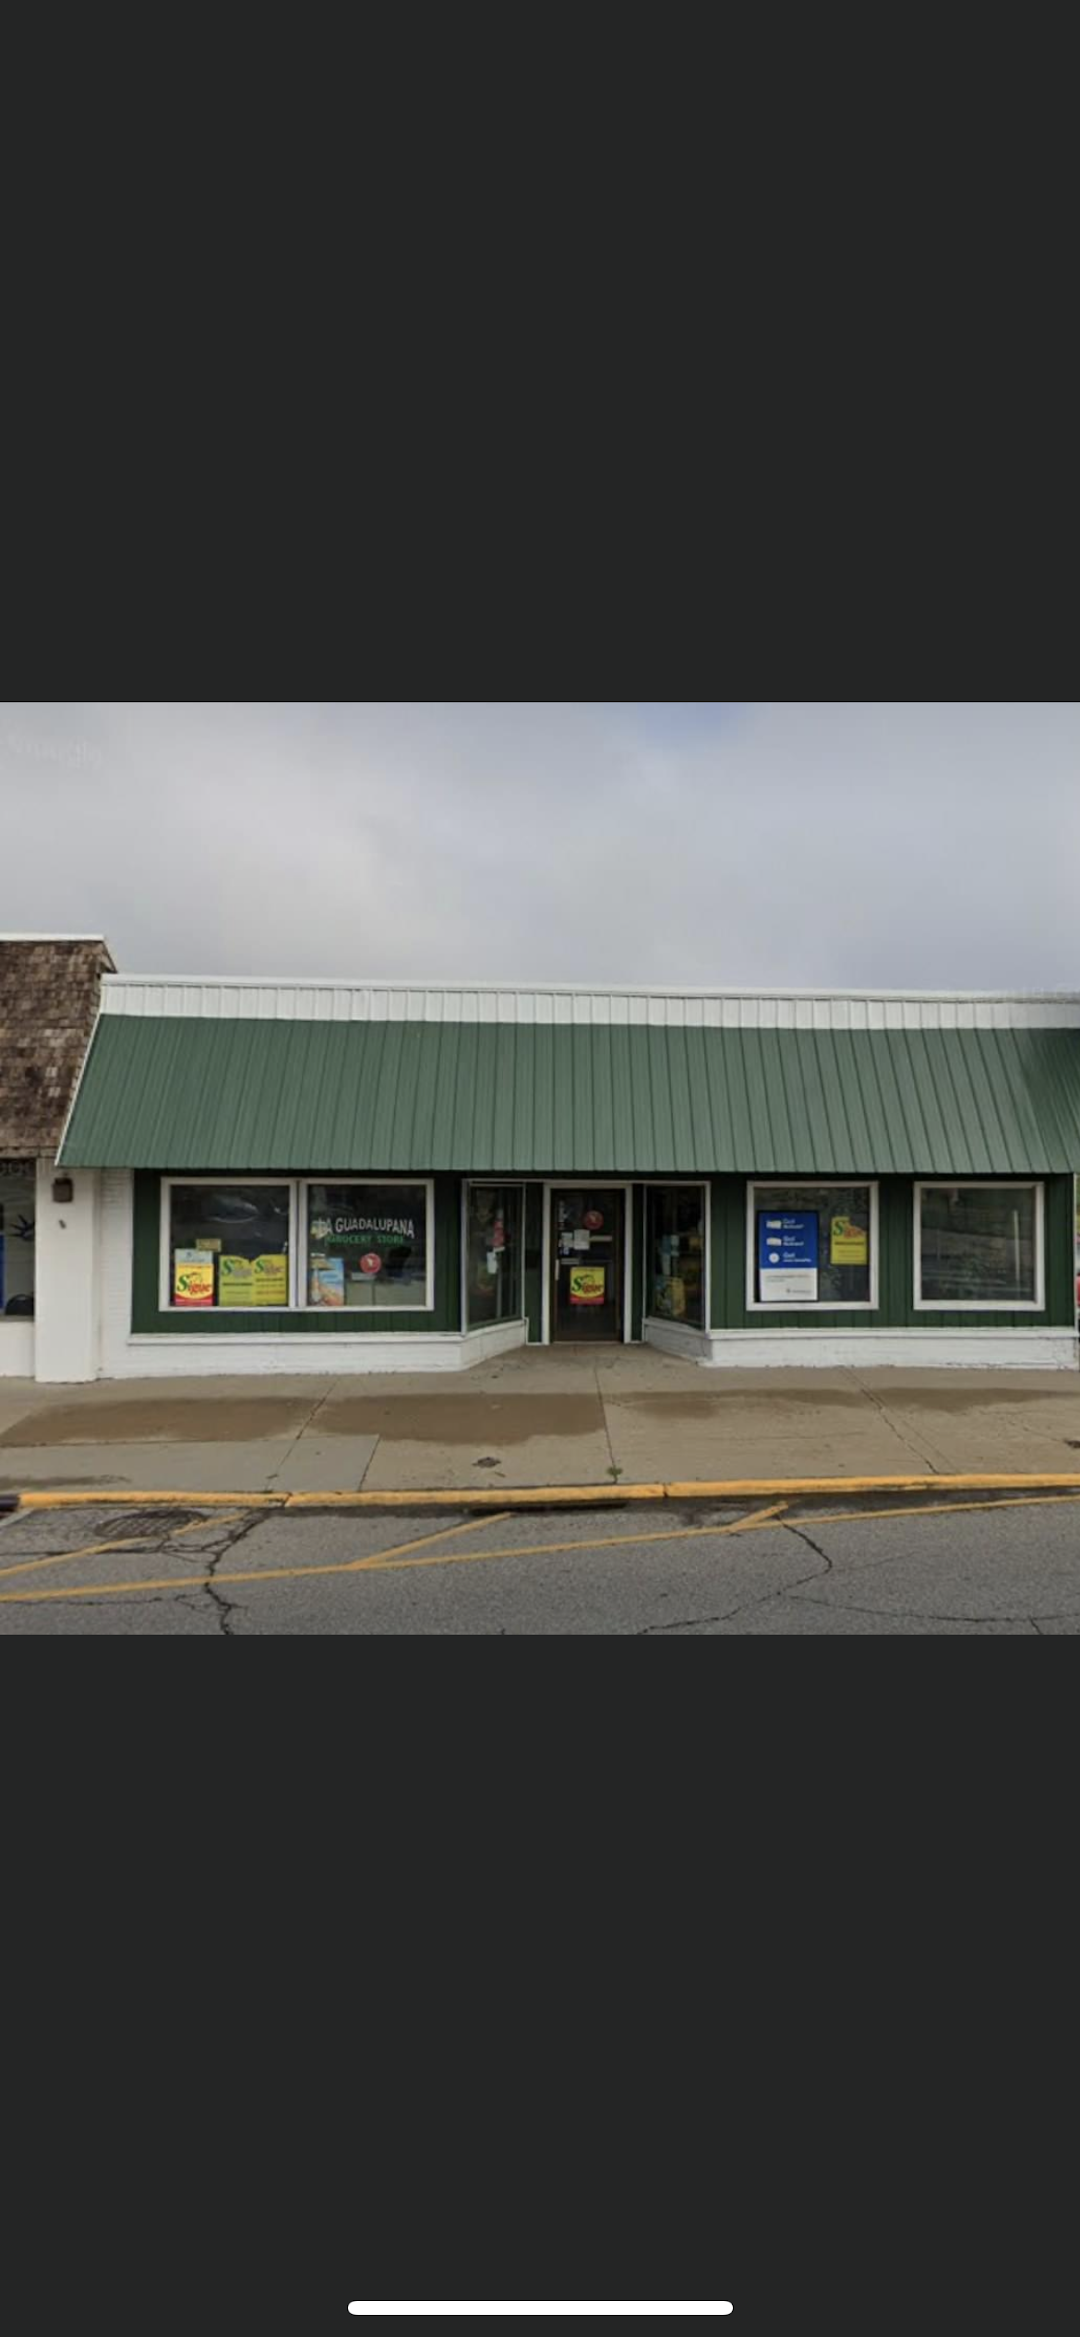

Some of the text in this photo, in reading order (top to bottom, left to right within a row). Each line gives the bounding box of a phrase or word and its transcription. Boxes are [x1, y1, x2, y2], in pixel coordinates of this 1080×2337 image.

[335, 1217, 415, 1239] GUADALUPANA
[326, 1234, 404, 1245] GROCERY STORE
